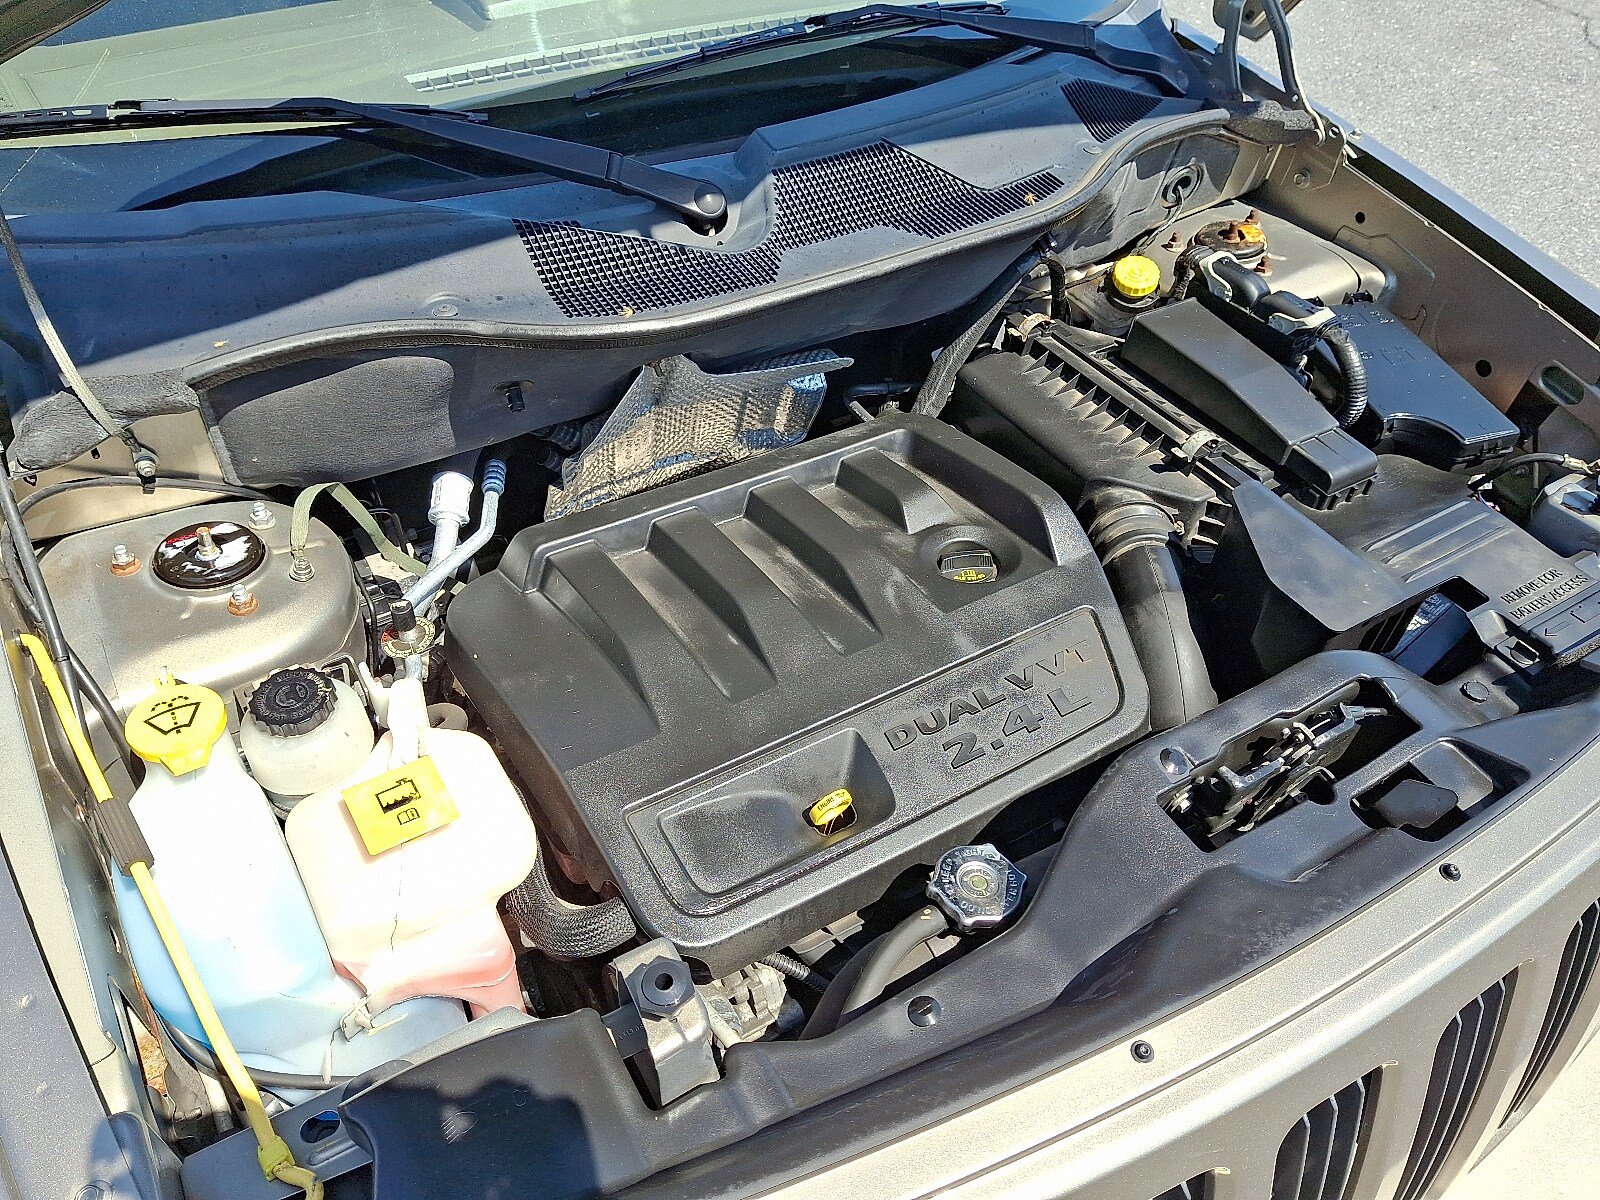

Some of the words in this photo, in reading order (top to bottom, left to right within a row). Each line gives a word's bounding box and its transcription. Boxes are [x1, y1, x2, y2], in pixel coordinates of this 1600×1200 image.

[1500, 579, 1542, 604] REMOVE
[1537, 568, 1563, 585] FOR
[1509, 594, 1552, 620] BATTERY
[1548, 574, 1589, 601] ACCESS
[883, 689, 1007, 751] DUAL
[1004, 638, 1092, 691] VVT
